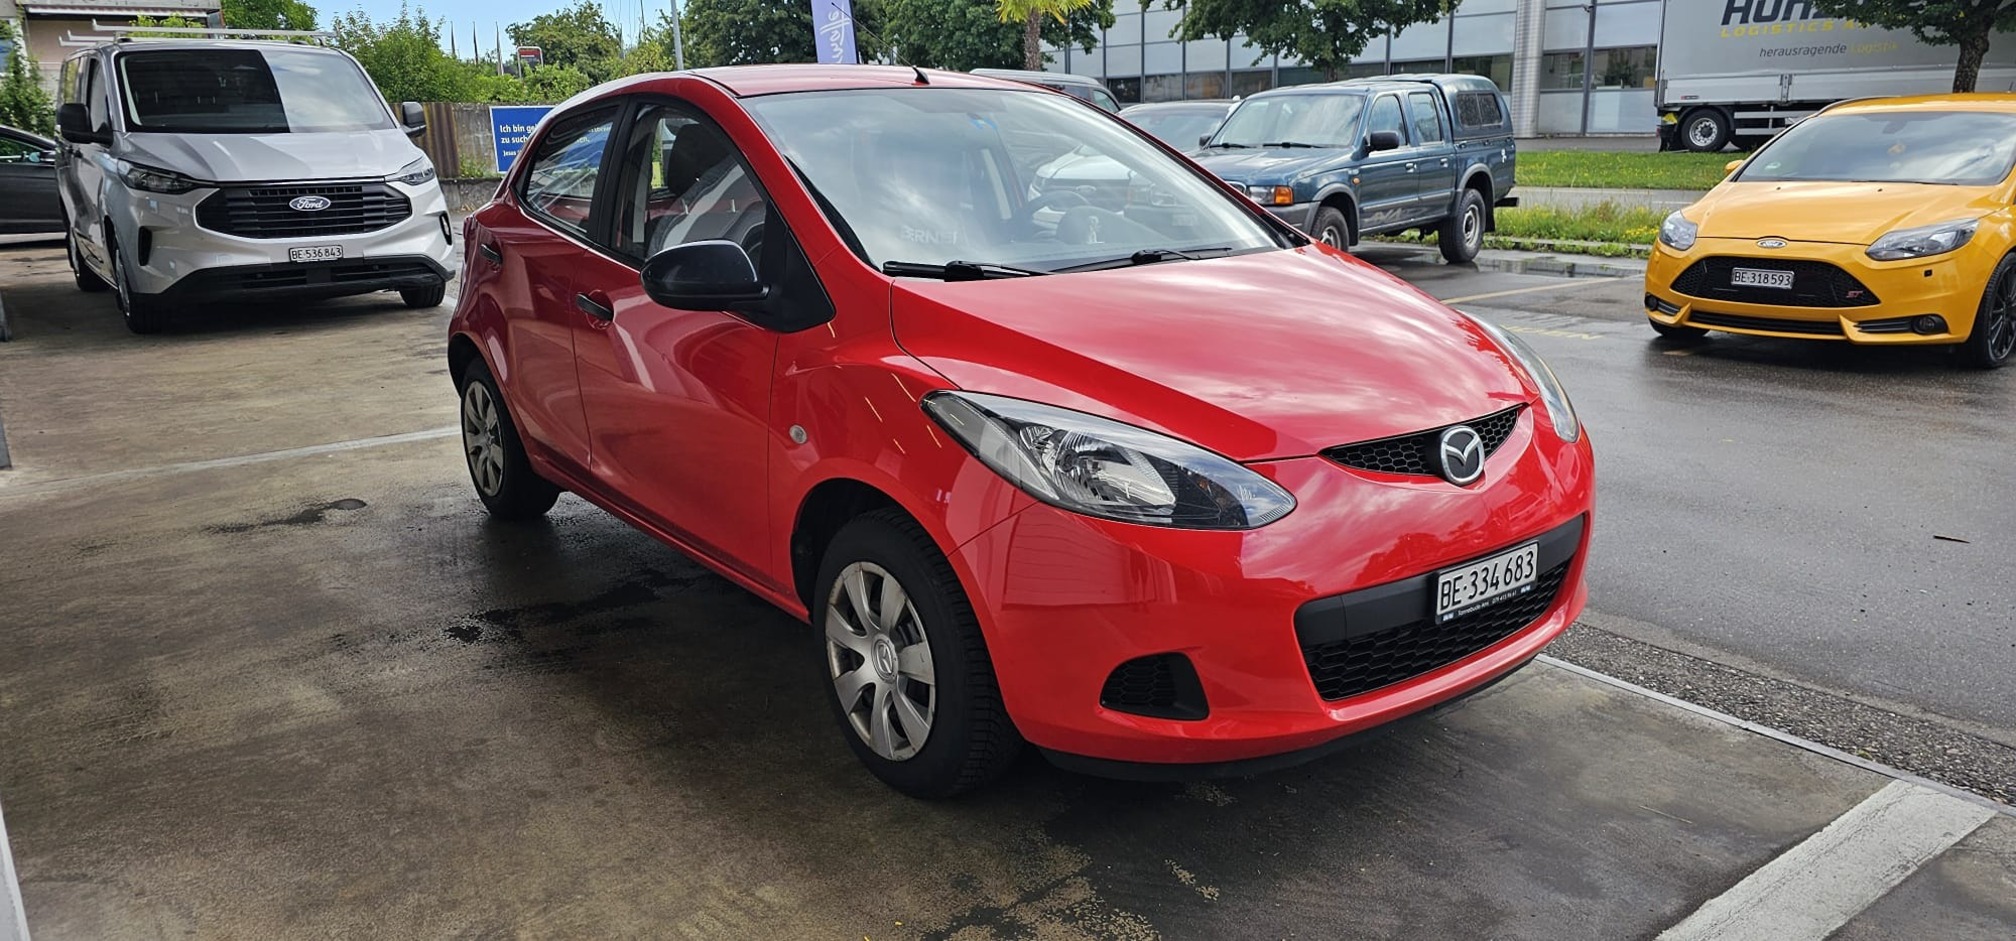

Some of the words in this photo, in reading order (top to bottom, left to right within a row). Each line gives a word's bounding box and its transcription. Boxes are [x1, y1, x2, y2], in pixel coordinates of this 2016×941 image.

[1721, 20, 1834, 39] LOGISTICS
[1759, 43, 1847, 57] herausragende
[500, 124, 511, 133] Ich
[512, 124, 525, 133] bin
[511, 135, 528, 144] such
